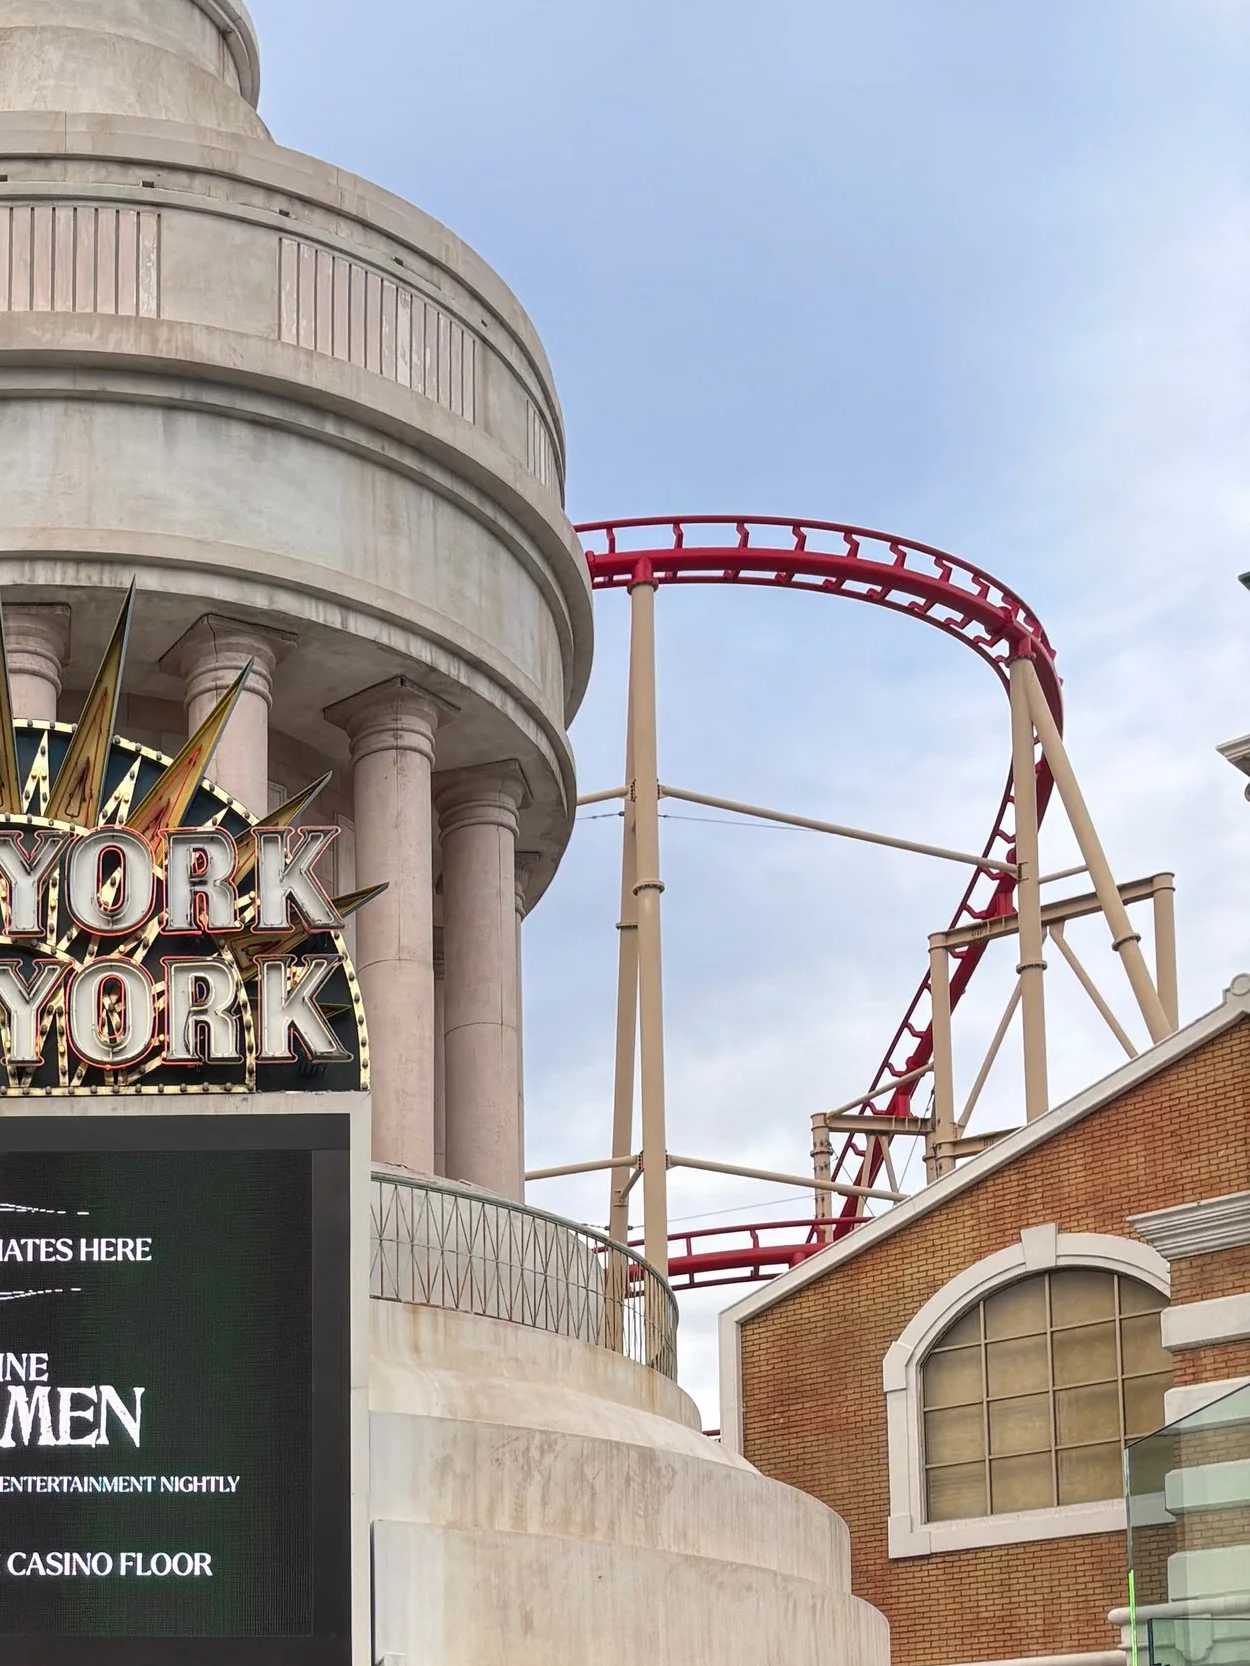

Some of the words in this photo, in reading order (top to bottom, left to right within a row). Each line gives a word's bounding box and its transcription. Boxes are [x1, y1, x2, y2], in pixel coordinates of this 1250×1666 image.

[80, 1238, 152, 1261] HERE
[0, 1476, 156, 1492] ENTERTAINMENT
[161, 1476, 240, 1492] NIGHTLY
[7, 1552, 113, 1576] CASINO
[120, 1552, 212, 1576] FLOOR
